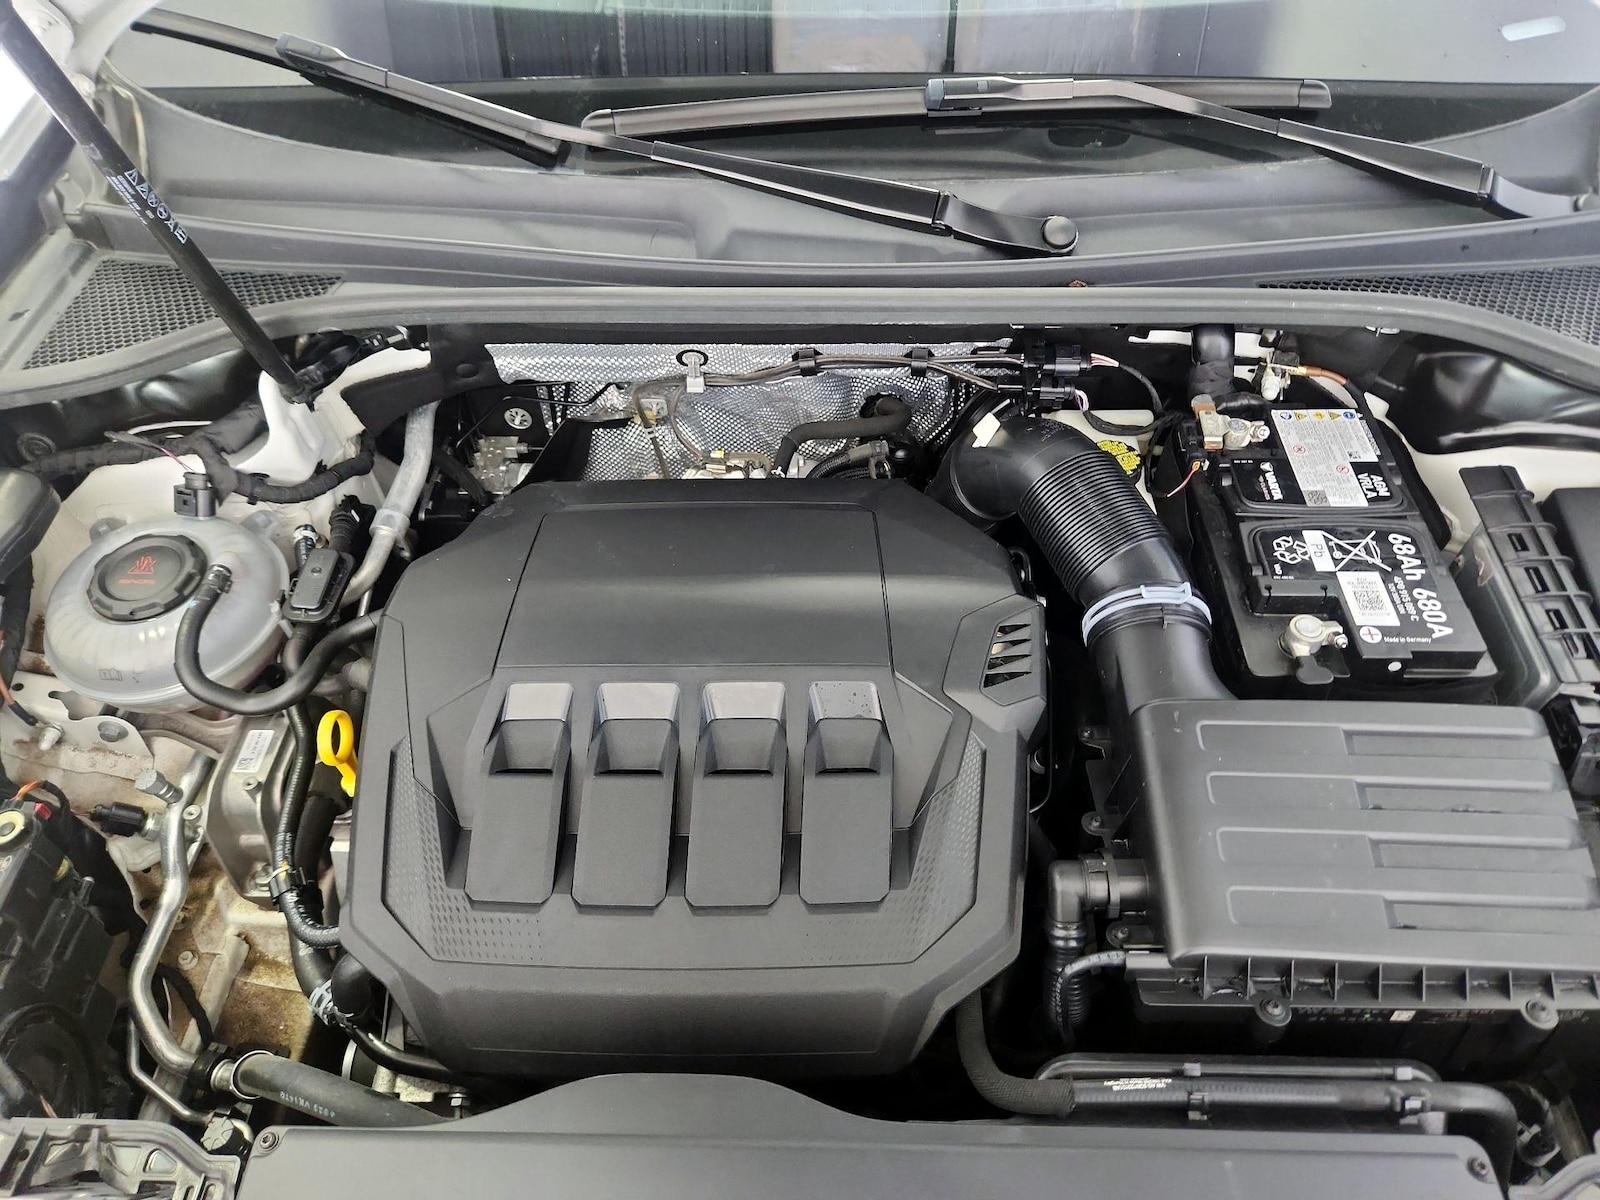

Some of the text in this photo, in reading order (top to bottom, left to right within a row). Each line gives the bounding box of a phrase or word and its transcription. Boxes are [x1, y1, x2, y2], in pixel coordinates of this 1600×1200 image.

[1264, 470, 1284, 501] VARTA
[1357, 472, 1378, 499] VRLA
[1370, 474, 1391, 497] AGM
[1311, 543, 1325, 558] Pb
[1387, 533, 1454, 639] 68Ah 680A
[1406, 636, 1432, 644] Germany
